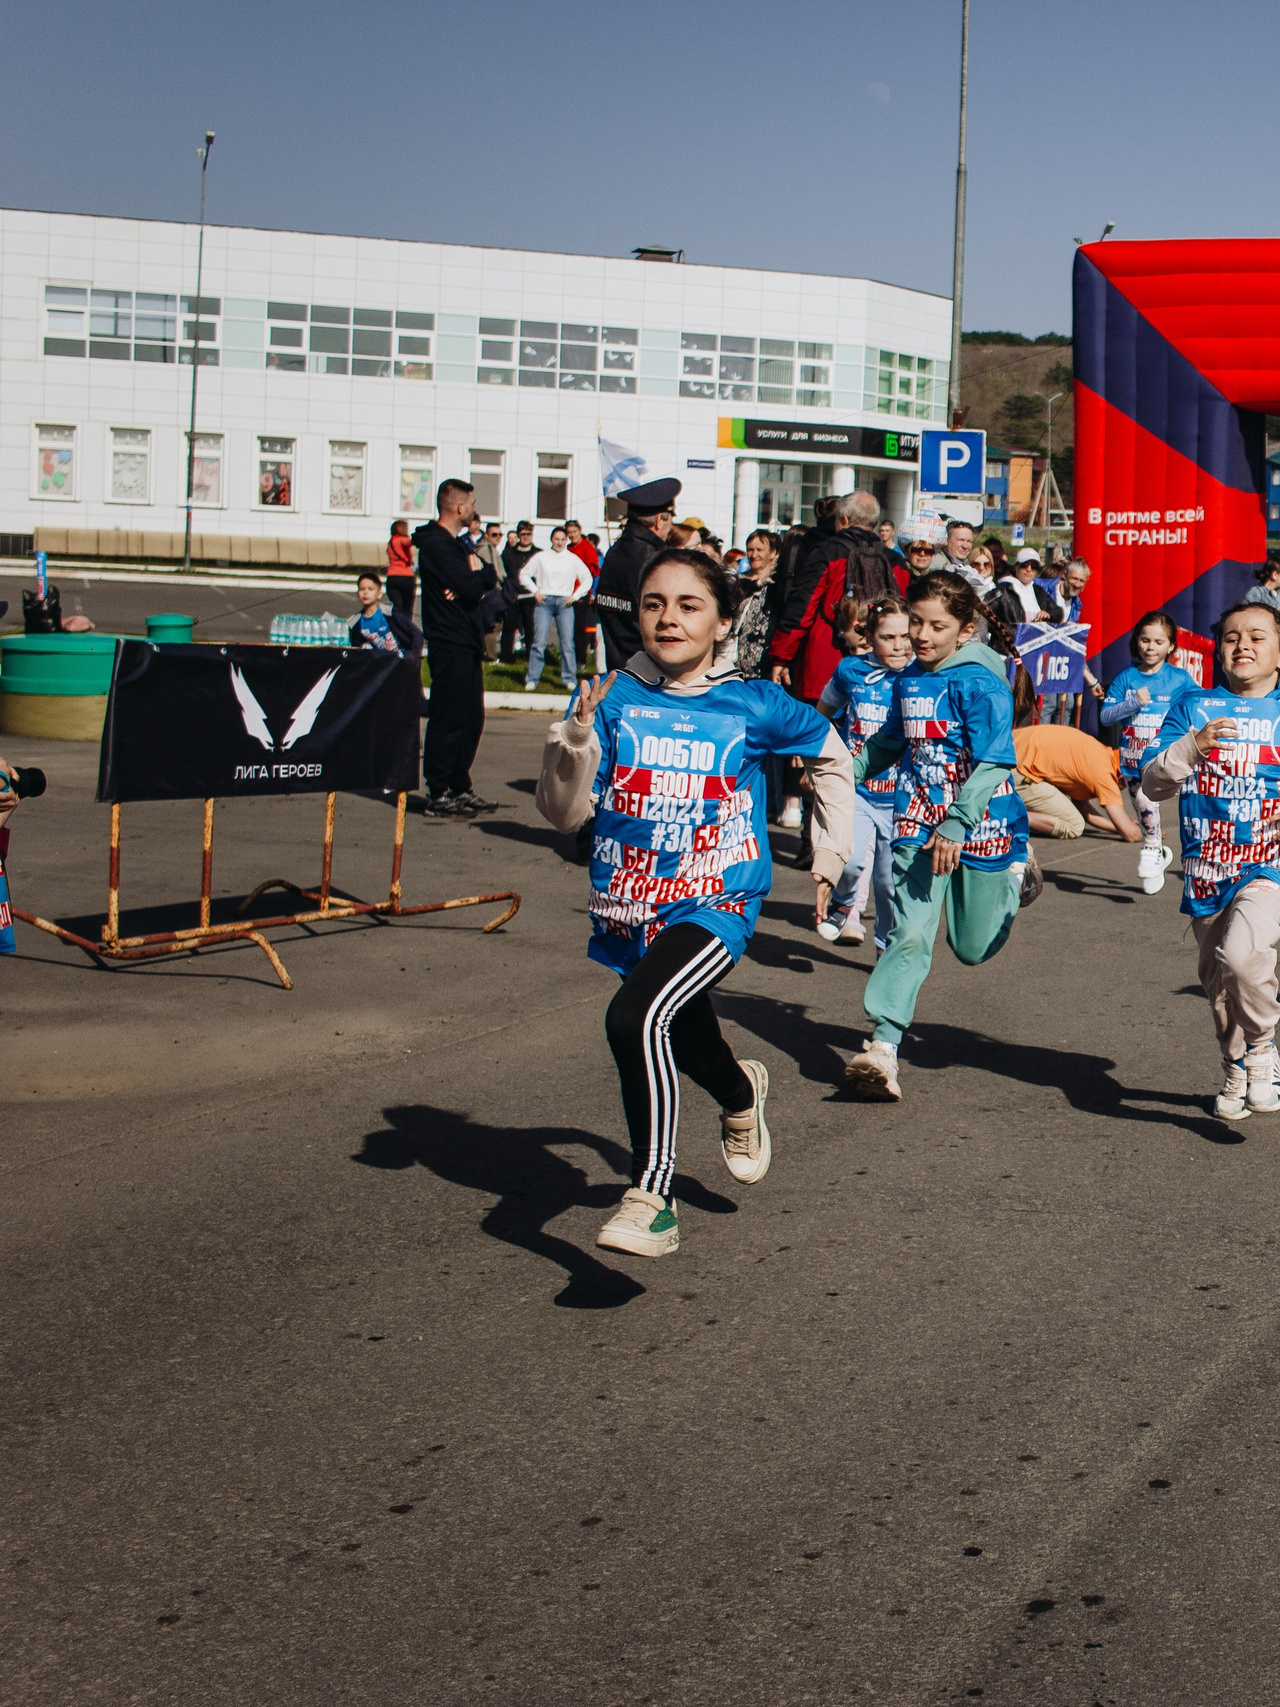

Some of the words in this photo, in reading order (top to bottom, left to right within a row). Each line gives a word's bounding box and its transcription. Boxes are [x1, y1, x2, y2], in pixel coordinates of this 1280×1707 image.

[757, 429, 788, 440] УСЛУГИ
[791, 431, 809, 441] ДЛЯ
[813, 433, 849, 443] БИЗНЕСА
[1088, 508, 1102, 524] В
[1105, 509, 1161, 526] ритме
[1164, 506, 1205, 523] всей
[1105, 528, 1188, 546] СТРАНЫ!
[597, 593, 632, 612] ПОЛИЦИЯ
[1048, 656, 1070, 680] ПСБ
[641, 711, 660, 719] ПСБ
[641, 735, 716, 772] 00510
[234, 765, 269, 779] ЛИГА
[273, 764, 322, 778] ГЕРОЕВ
[608, 868, 725, 904] #ГОРДОСТЬ
